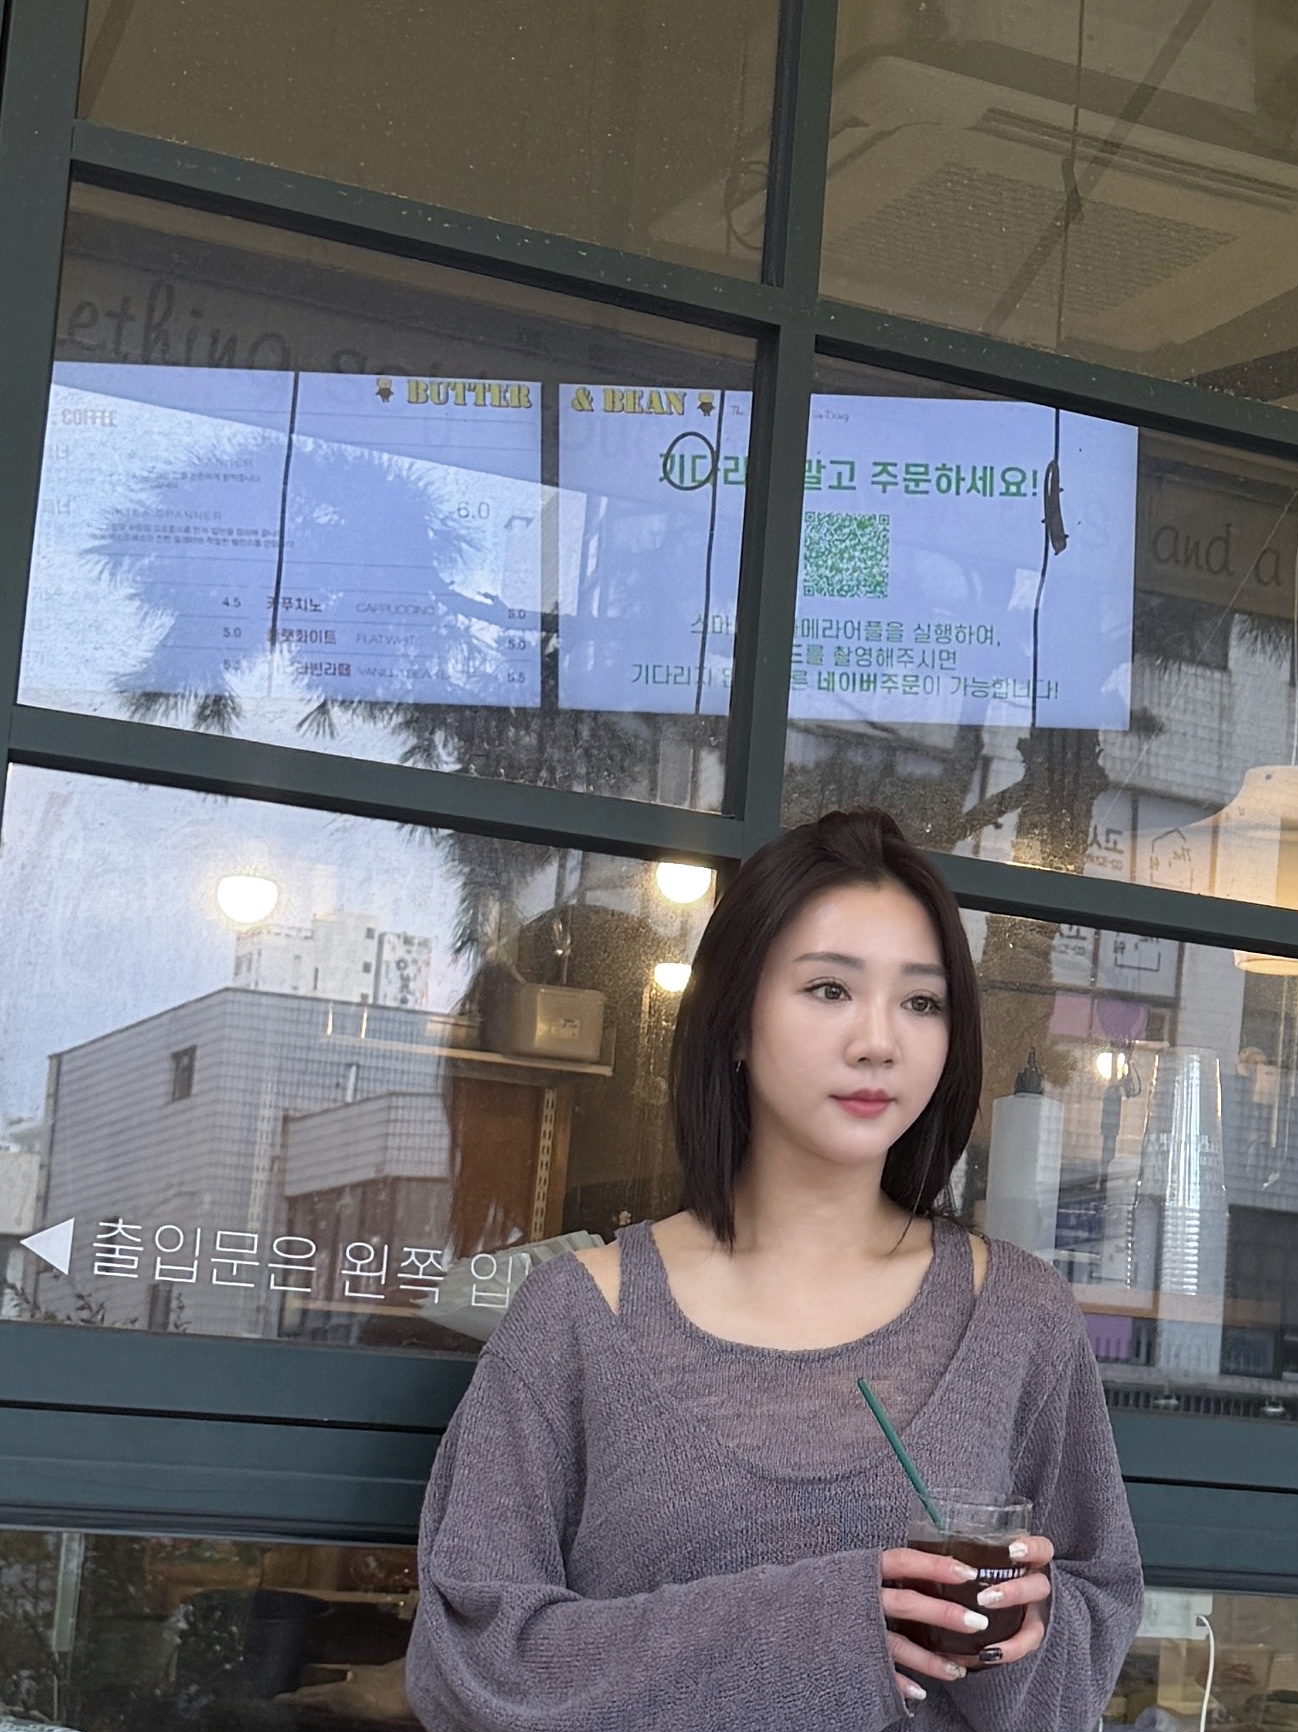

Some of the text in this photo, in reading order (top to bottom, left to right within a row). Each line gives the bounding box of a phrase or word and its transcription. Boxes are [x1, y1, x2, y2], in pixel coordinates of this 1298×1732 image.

[407, 379, 687, 416] BUTTER & BEAN
[870, 460, 1039, 498] 주문하세요!
[456, 500, 490, 520] 6.0
[1153, 522, 1235, 577] and
[1255, 547, 1282, 588] a
[912, 622, 1001, 648] 실행하여,
[817, 670, 941, 696] 네이버주문이
[92, 1216, 532, 1309] 출입문은 왼쪽 입
